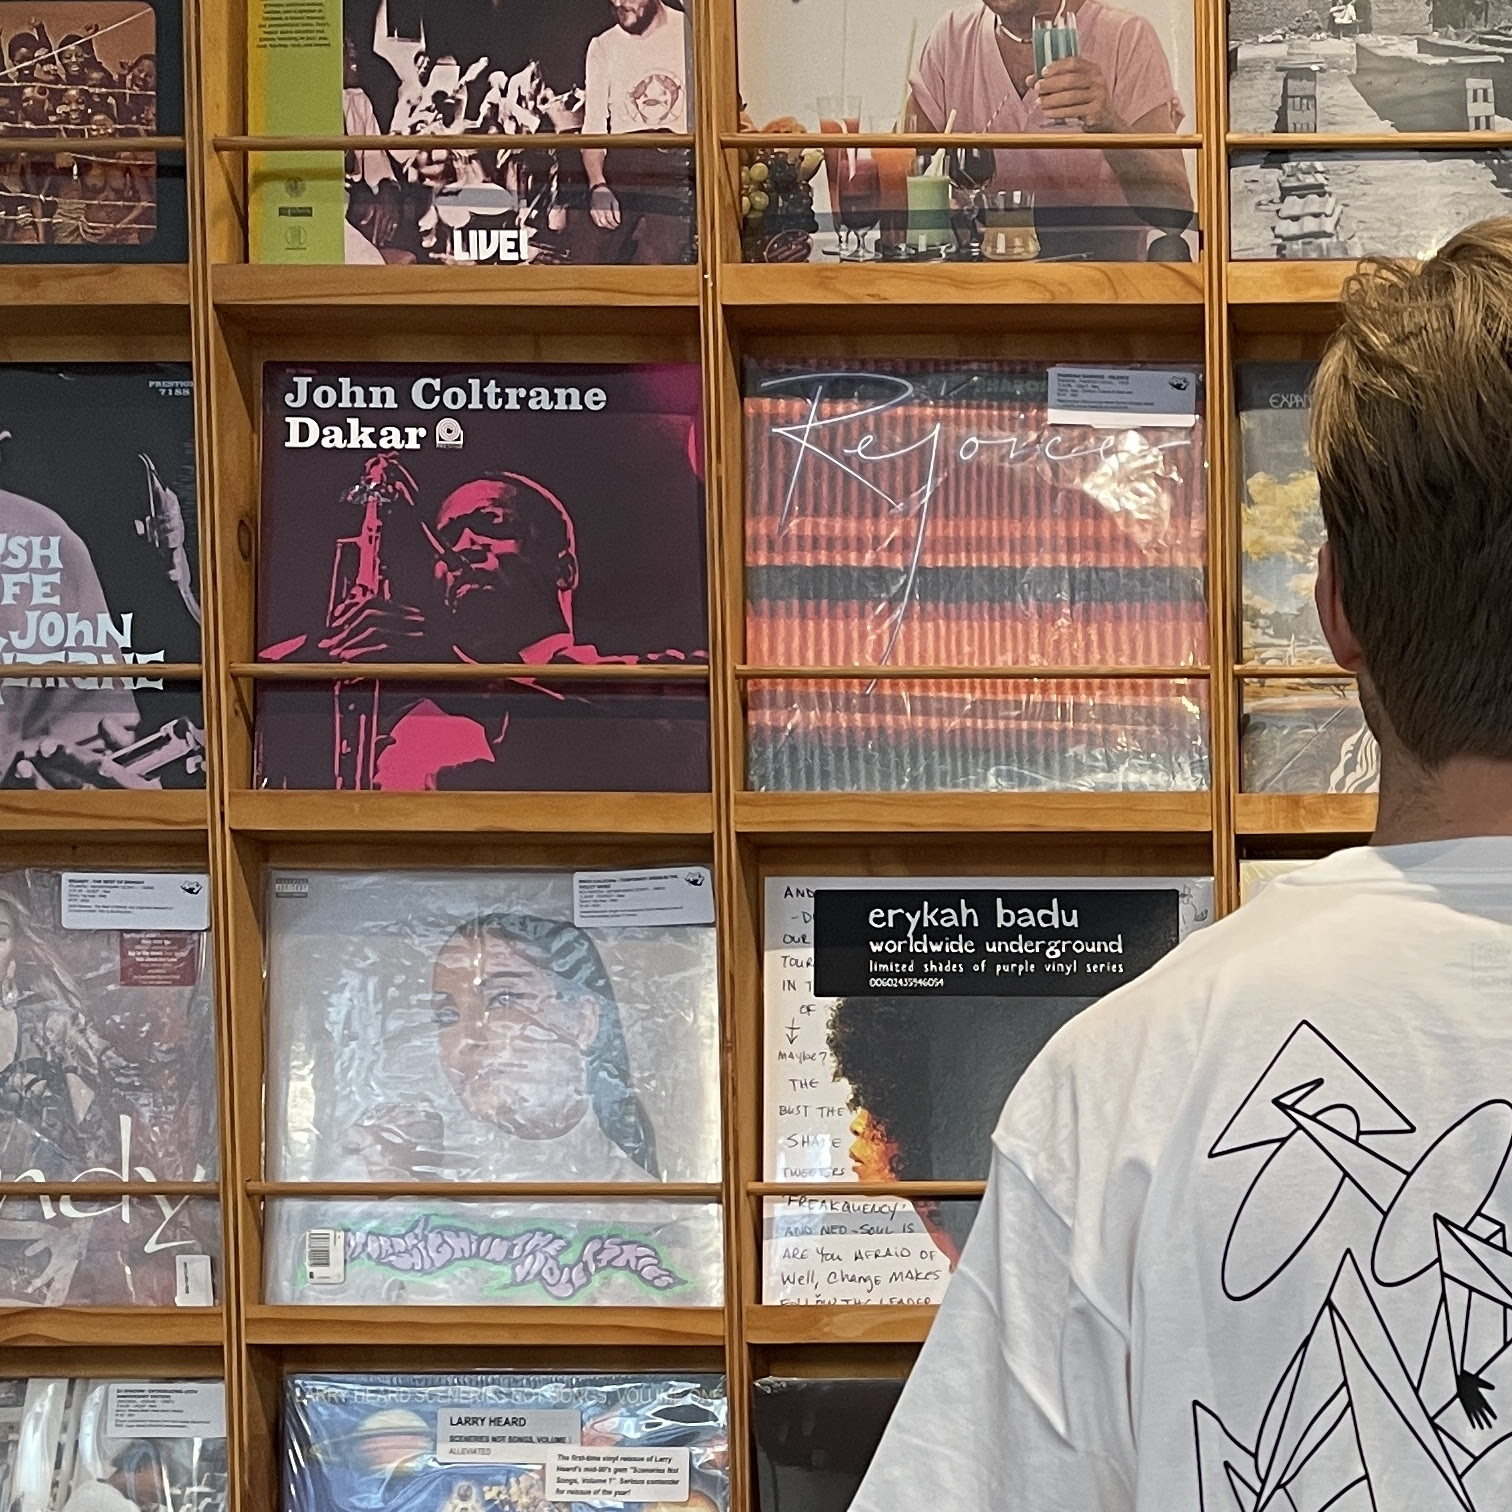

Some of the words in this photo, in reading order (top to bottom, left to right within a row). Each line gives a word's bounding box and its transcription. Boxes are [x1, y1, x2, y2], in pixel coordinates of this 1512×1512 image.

[453, 229, 528, 261] LIVE!
[284, 376, 398, 410] John
[411, 377, 608, 411] Coltrane
[284, 416, 427, 450] Dakar
[868, 898, 979, 937] erykah
[996, 898, 1079, 929] badu
[868, 934, 976, 954] worldwide
[985, 935, 1123, 958] underground
[869, 960, 914, 973] limited
[924, 959, 964, 973] shades
[973, 960, 986, 973] of
[996, 960, 1036, 976] purple
[1044, 959, 1078, 975] vinyl
[1086, 960, 1124, 973] series
[449, 1417, 486, 1427] LARRY
[489, 1417, 527, 1427] HEARD
[655, 1456, 673, 1464] Larry
